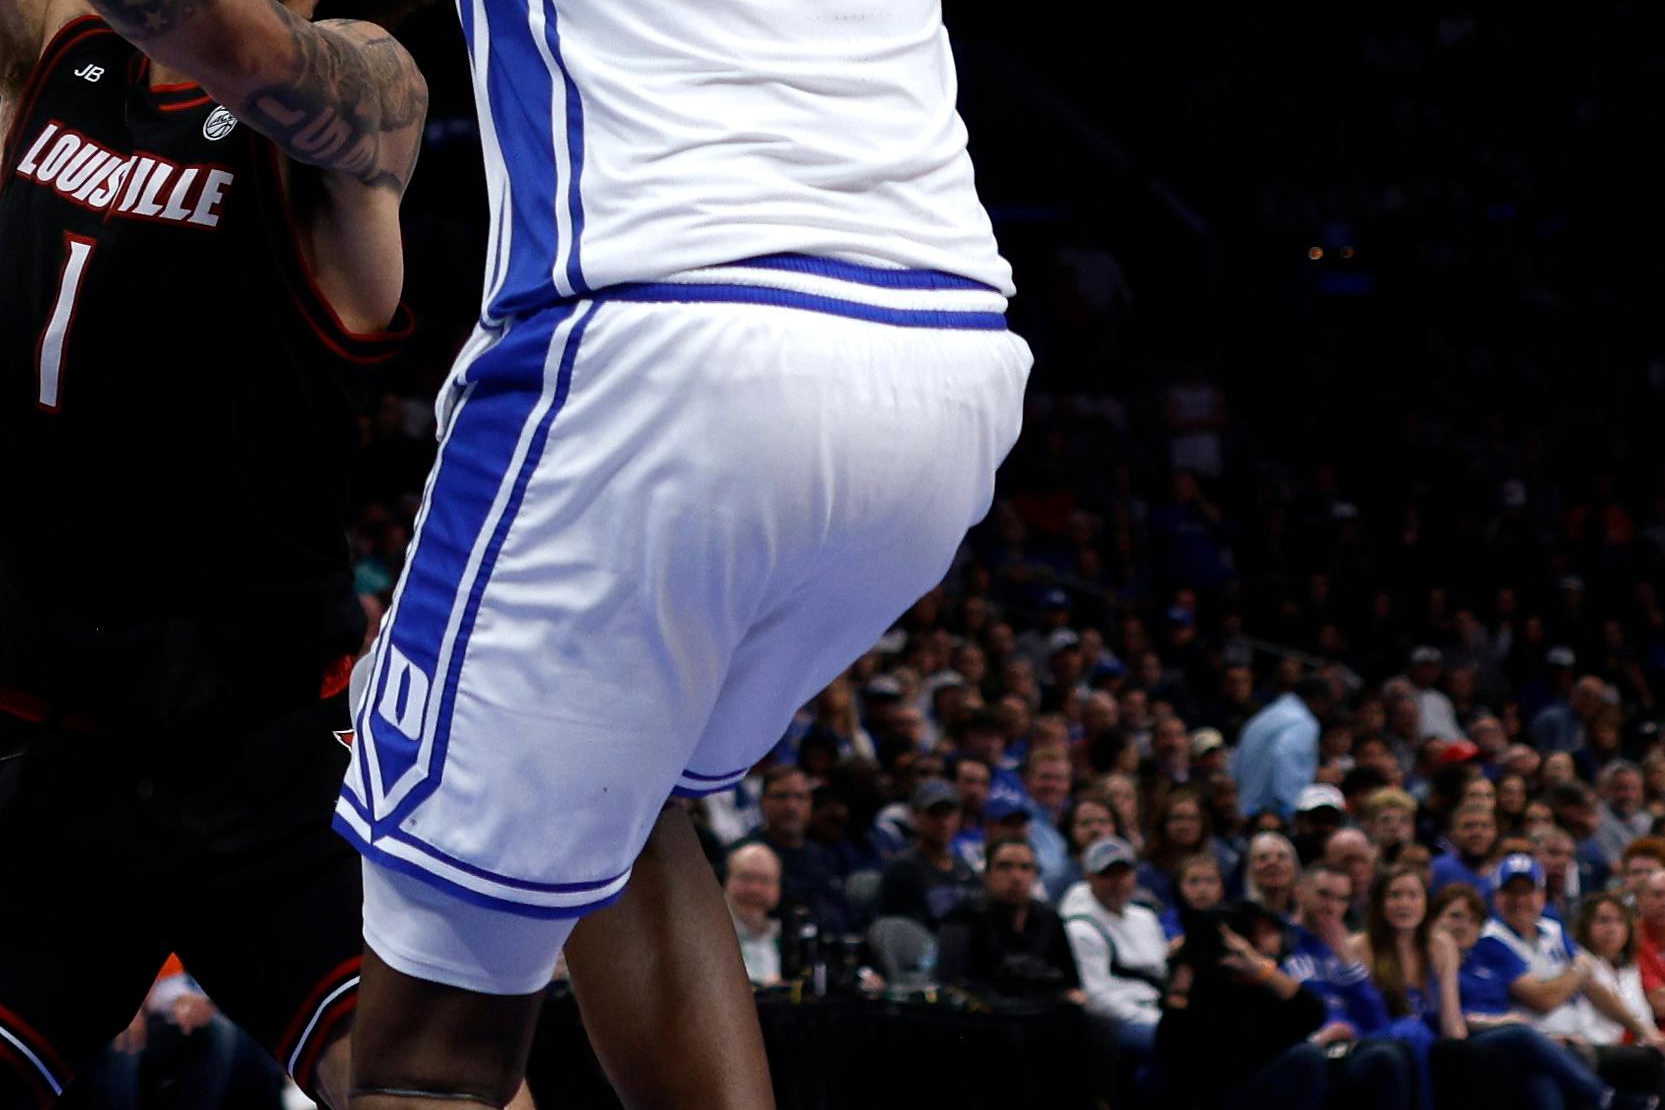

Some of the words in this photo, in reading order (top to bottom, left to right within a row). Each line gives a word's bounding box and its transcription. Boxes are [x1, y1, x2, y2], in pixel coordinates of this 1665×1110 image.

[74, 64, 105, 82] JB
[37, 234, 95, 411] 1
[378, 643, 429, 740] D
